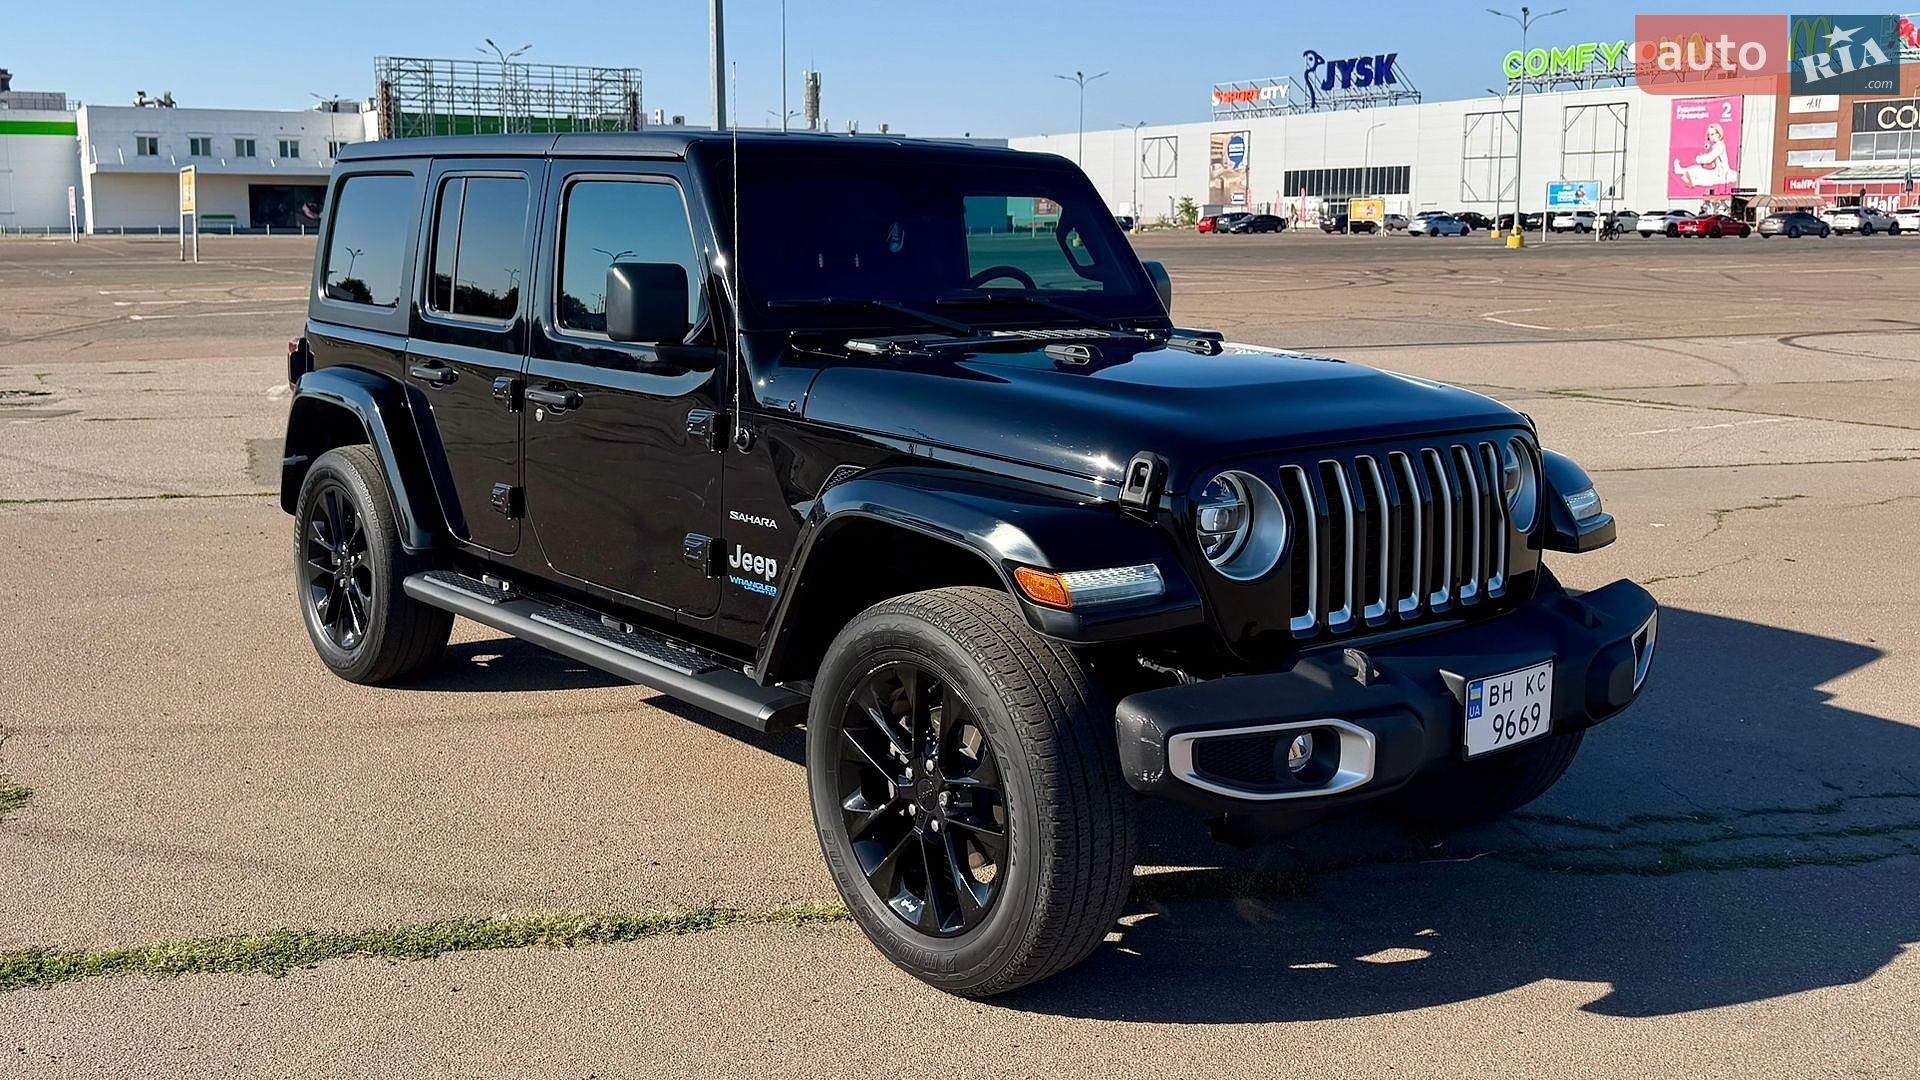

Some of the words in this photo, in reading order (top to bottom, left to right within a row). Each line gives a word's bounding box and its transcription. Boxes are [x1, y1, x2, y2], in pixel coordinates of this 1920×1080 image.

[1503, 40, 1627, 79] COMFY
[1320, 52, 1399, 92] JYSK
[1721, 102, 1732, 118] 2
[1877, 105, 1920, 129] CO
[1867, 195, 1900, 212] Half
[729, 510, 778, 529] SAHARA
[729, 544, 777, 582] Jeep
[729, 575, 777, 594] WRANGLER
[1488, 680, 1513, 707] BH
[1525, 671, 1546, 697] KC
[1469, 704, 1480, 718] UA
[1492, 702, 1541, 745] 9669
